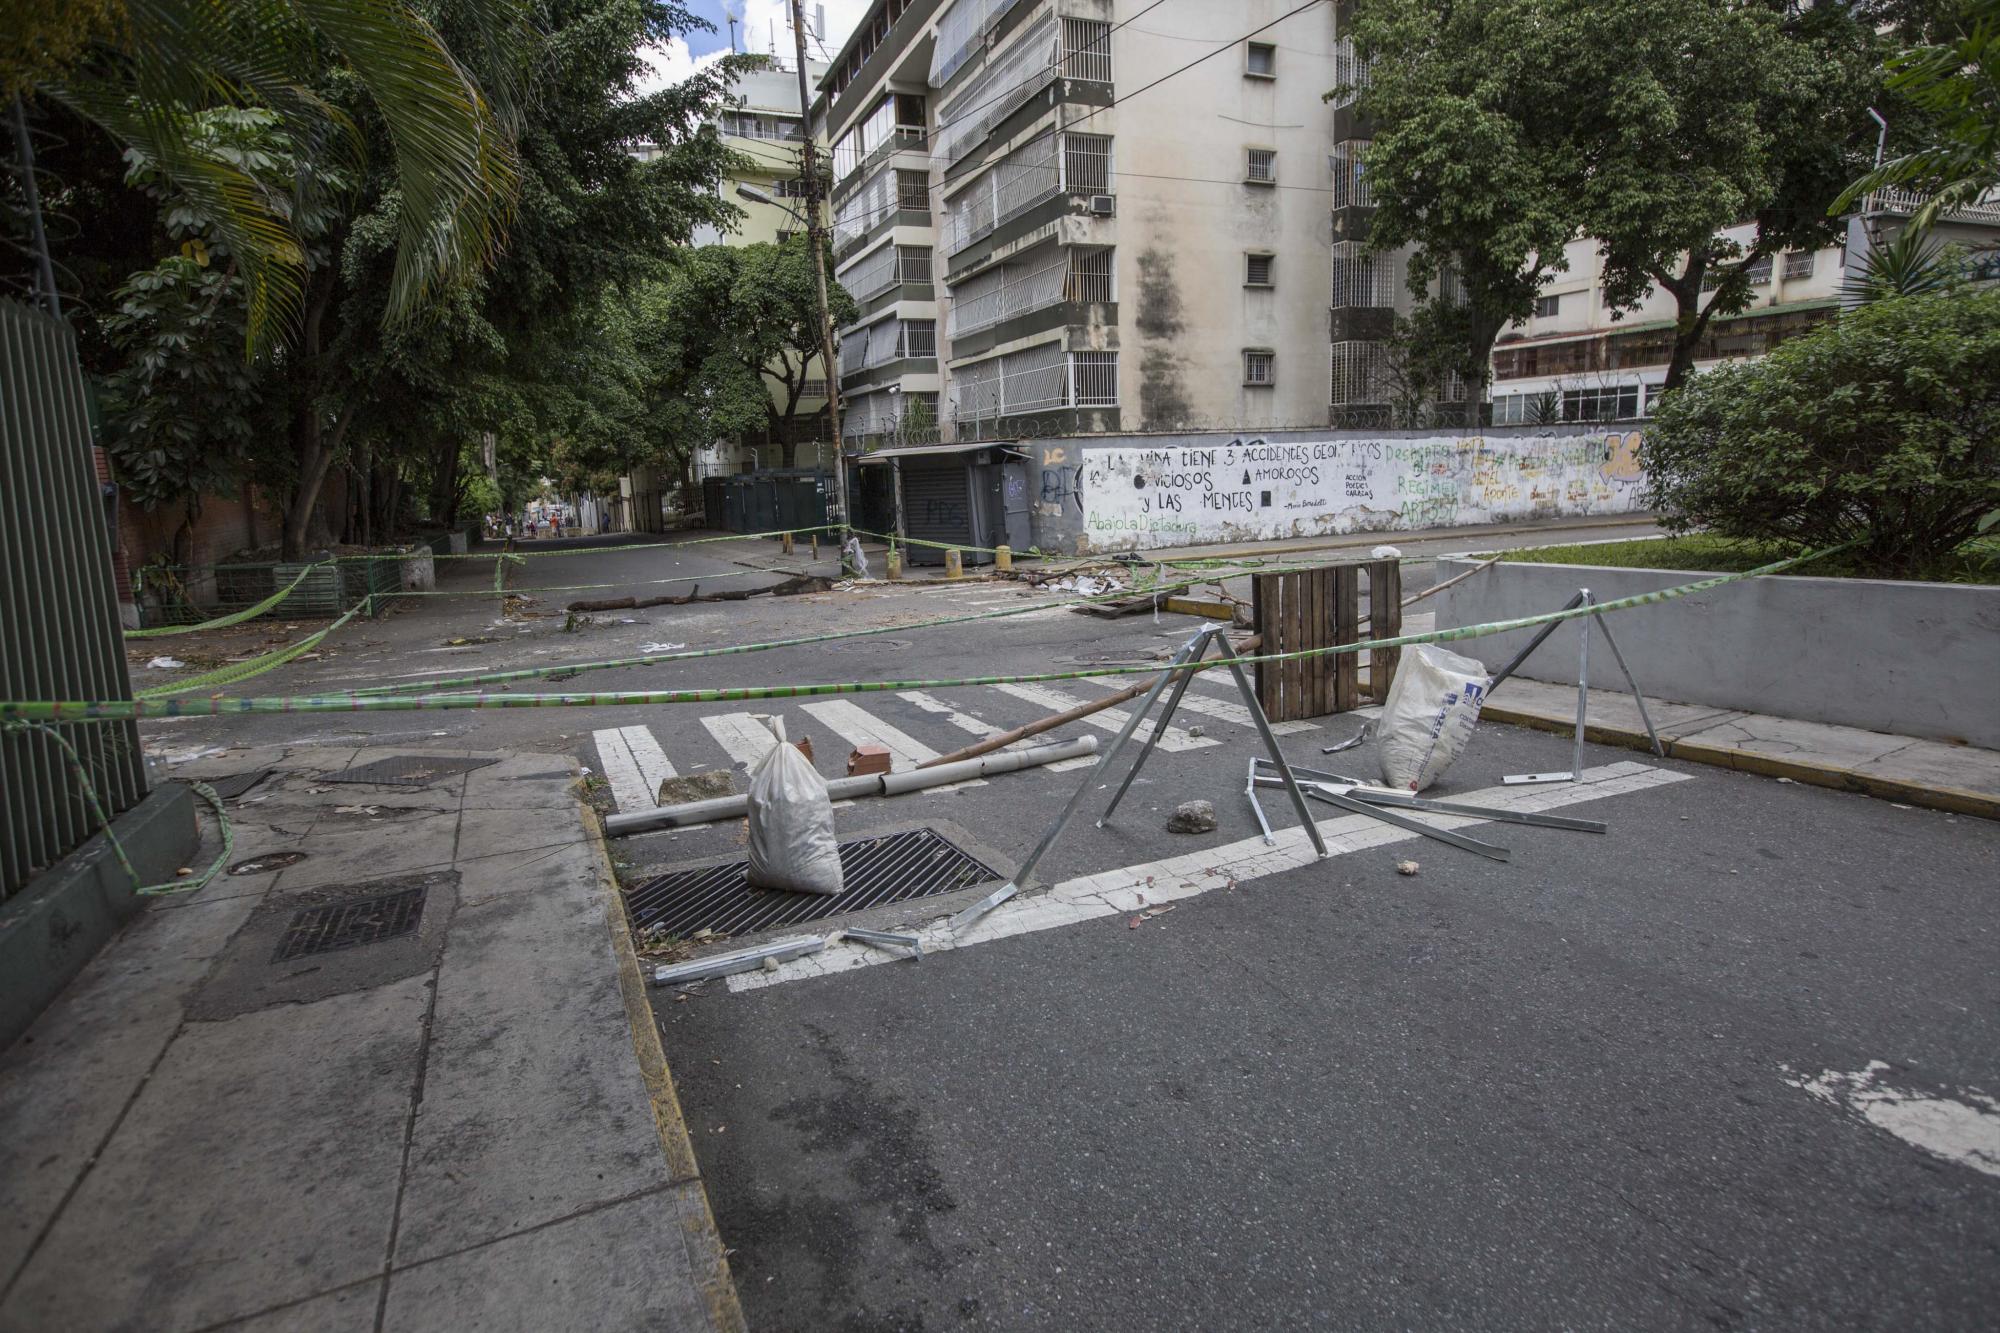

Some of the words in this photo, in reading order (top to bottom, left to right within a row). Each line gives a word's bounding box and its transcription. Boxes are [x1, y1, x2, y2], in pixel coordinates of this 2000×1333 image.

[1224, 450, 1235, 466] 3
[1242, 445, 1309, 464] ACCIDENTES
[1255, 466, 1320, 486] AMOROSOS
[1158, 493, 1182, 512] LAS
[1202, 491, 1252, 512] MENTES
